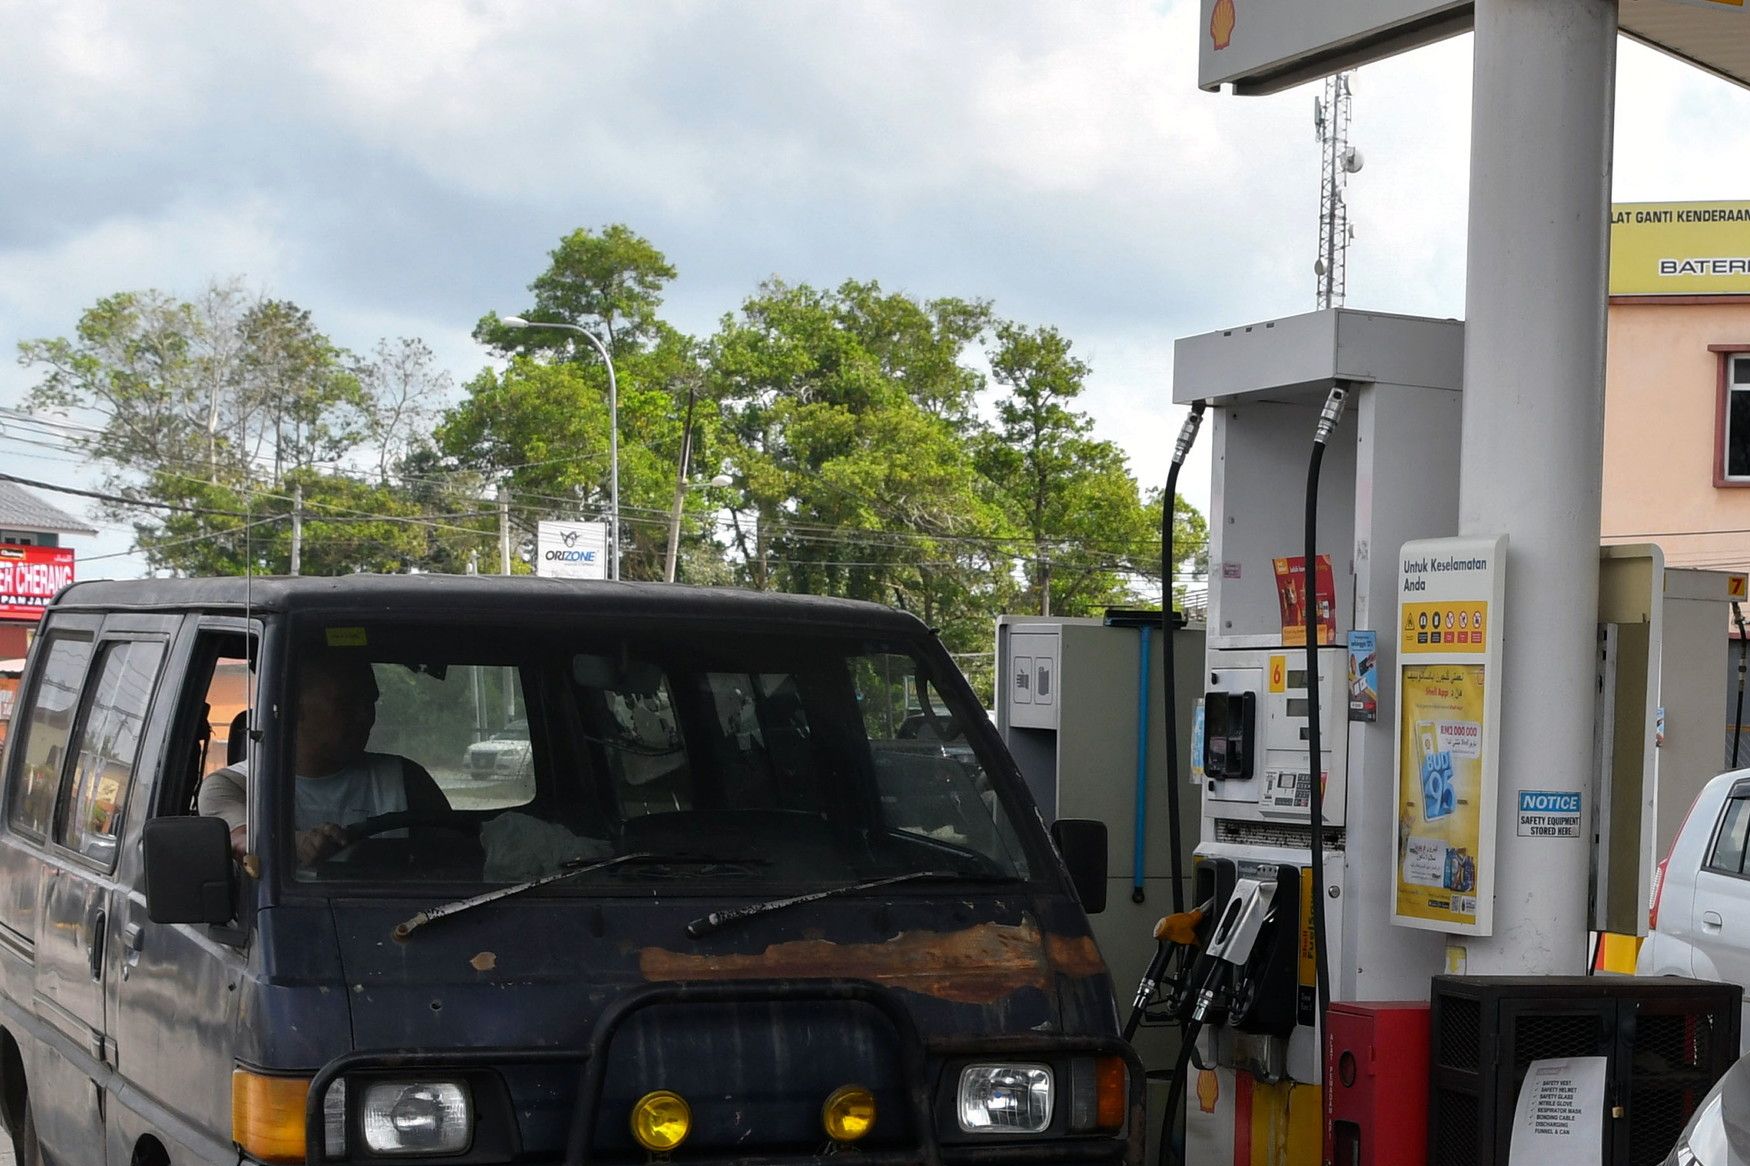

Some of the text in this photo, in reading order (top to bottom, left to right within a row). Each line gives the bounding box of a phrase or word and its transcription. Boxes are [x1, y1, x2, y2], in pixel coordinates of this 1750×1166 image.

[1636, 210, 1673, 223] GANTI
[545, 550, 595, 562] ORIZONE
[1403, 556, 1487, 573] Untuk Keselamatan
[1403, 576, 1426, 591] Anda
[1731, 577, 1743, 595] 7
[1272, 664, 1281, 685] 6
[1523, 795, 1578, 810] NOTICE
[1521, 816, 1580, 826] SAFETY EQUIPMENT
[1530, 826, 1572, 836] STORED HERE
